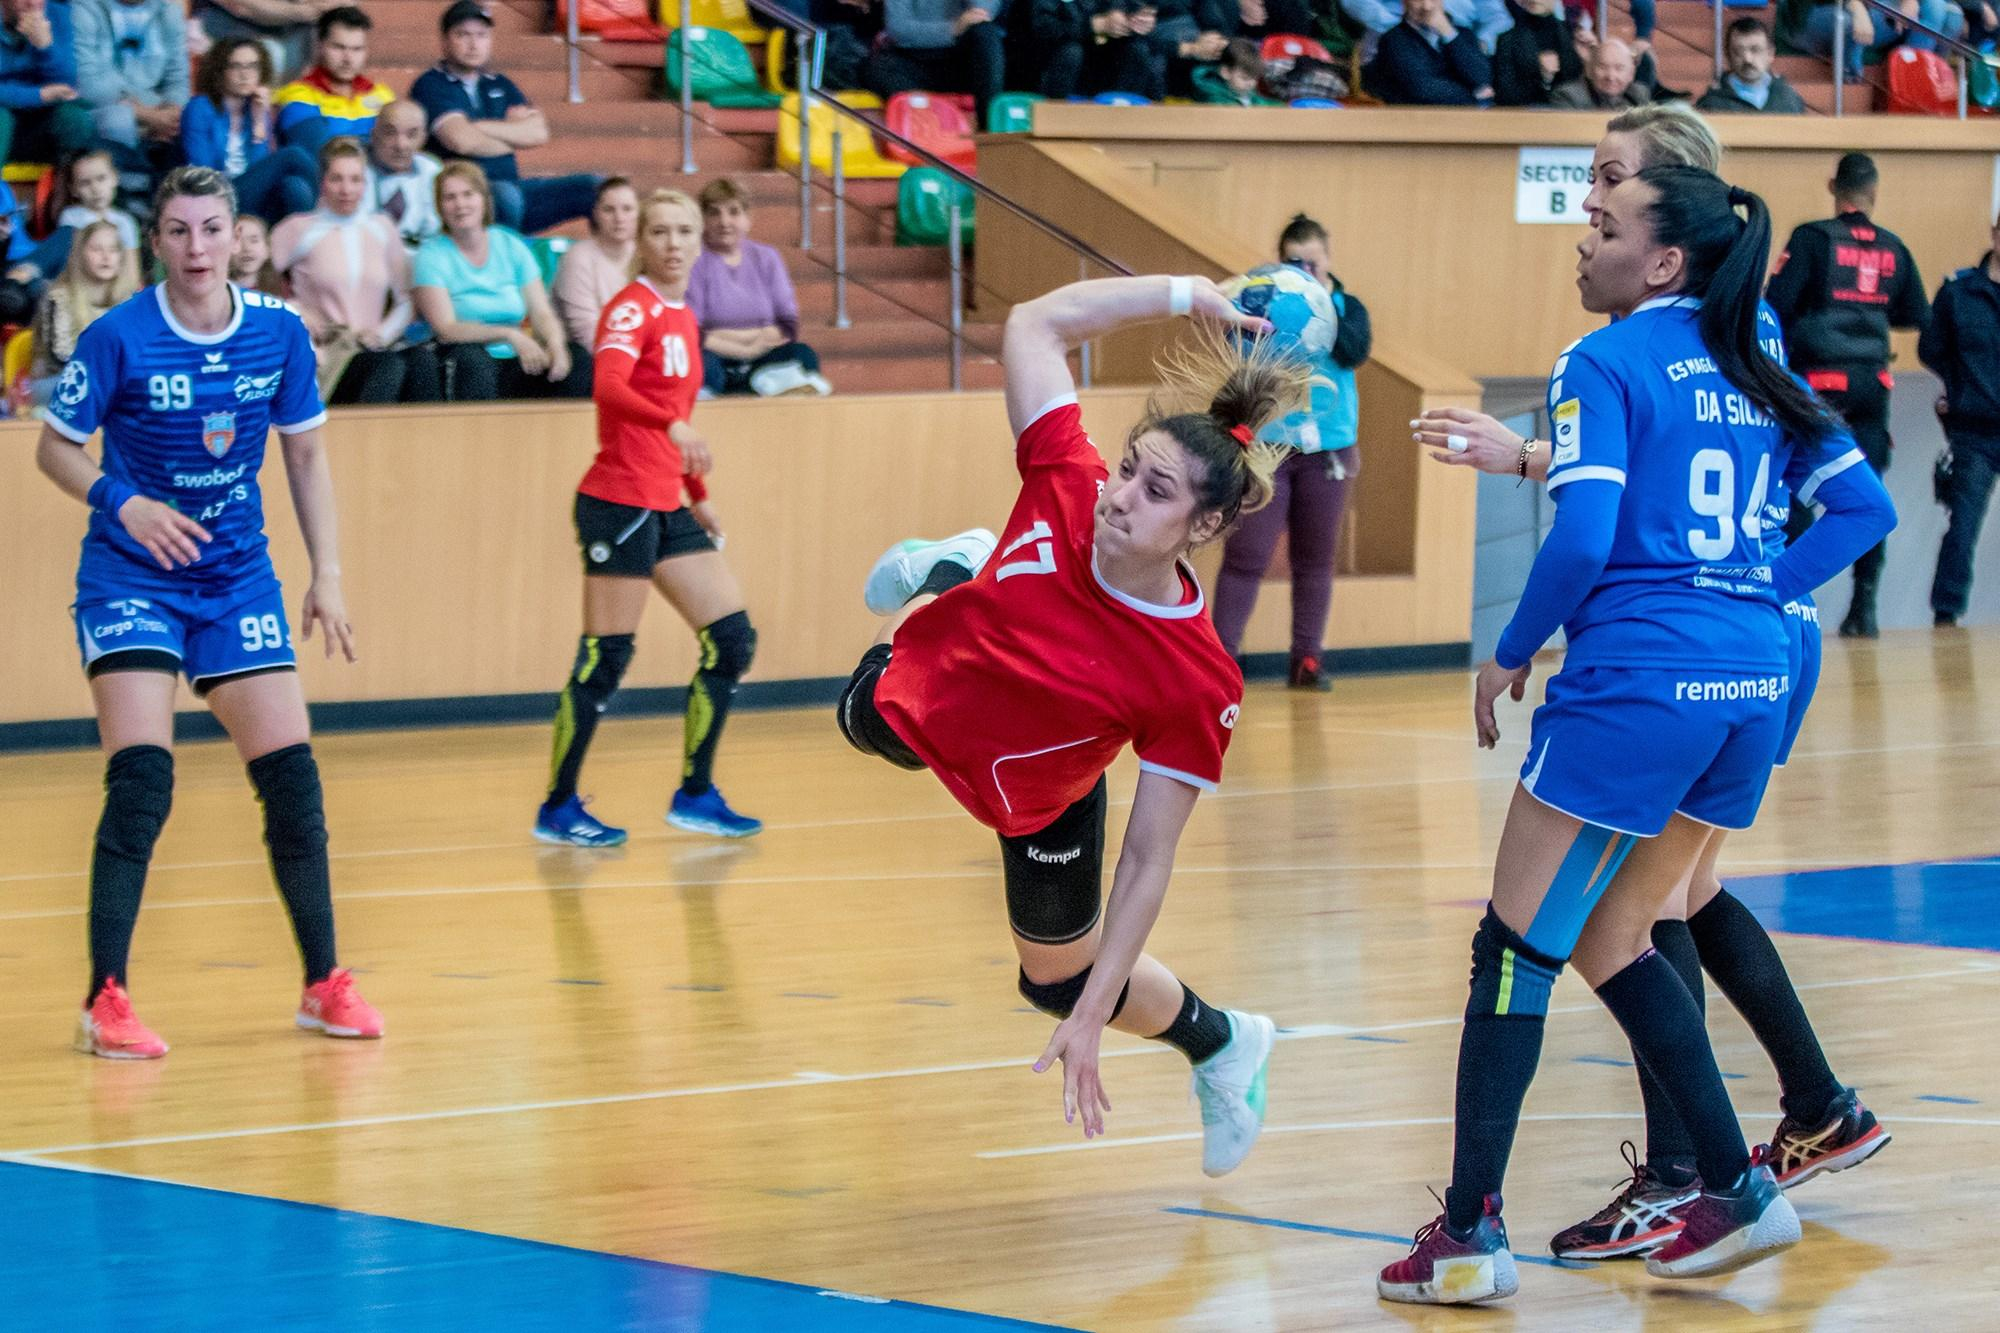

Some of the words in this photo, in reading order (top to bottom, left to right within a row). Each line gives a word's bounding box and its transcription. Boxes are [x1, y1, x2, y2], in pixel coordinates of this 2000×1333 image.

[1551, 191, 1566, 214] B
[661, 334, 689, 378] 10
[1666, 361, 1689, 382] CS
[148, 374, 192, 411] 99
[1695, 389, 1722, 424] DA
[1688, 448, 1770, 561] 94
[996, 521, 1057, 583] 17
[239, 613, 283, 652] 99
[1027, 846, 1081, 865] Kempa
